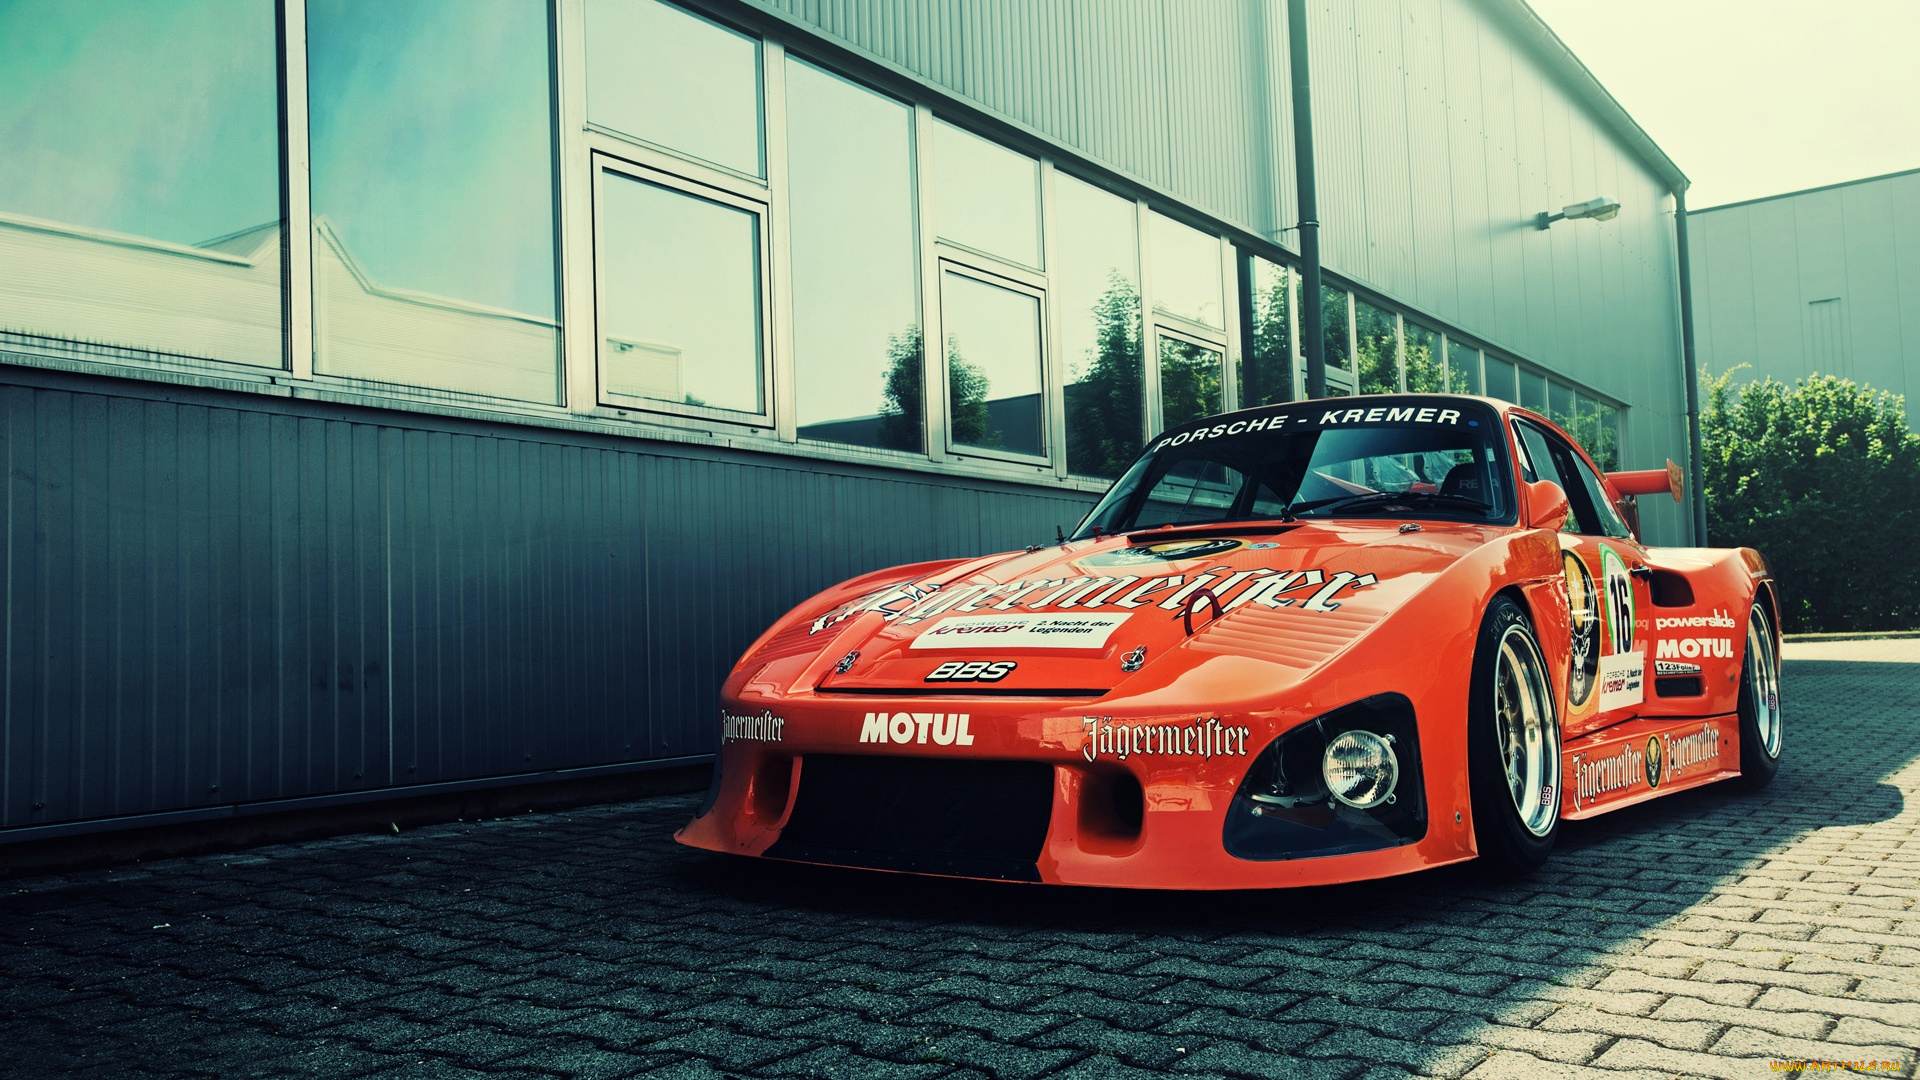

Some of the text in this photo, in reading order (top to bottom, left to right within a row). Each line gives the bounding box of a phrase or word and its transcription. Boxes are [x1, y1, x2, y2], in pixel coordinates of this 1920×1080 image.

[1153, 414, 1288, 453] PORSCHE
[1319, 407, 1461, 425] KREMER
[1610, 574, 1631, 654] 16
[1655, 609, 1736, 630] powerslide
[928, 625, 1025, 635] kremer
[1029, 626, 1093, 634] Legenden
[1656, 638, 1734, 658] MOTUL
[924, 661, 1017, 682] BBS
[859, 712, 975, 746] MOTUL
[1540, 785, 1553, 806] BBS
